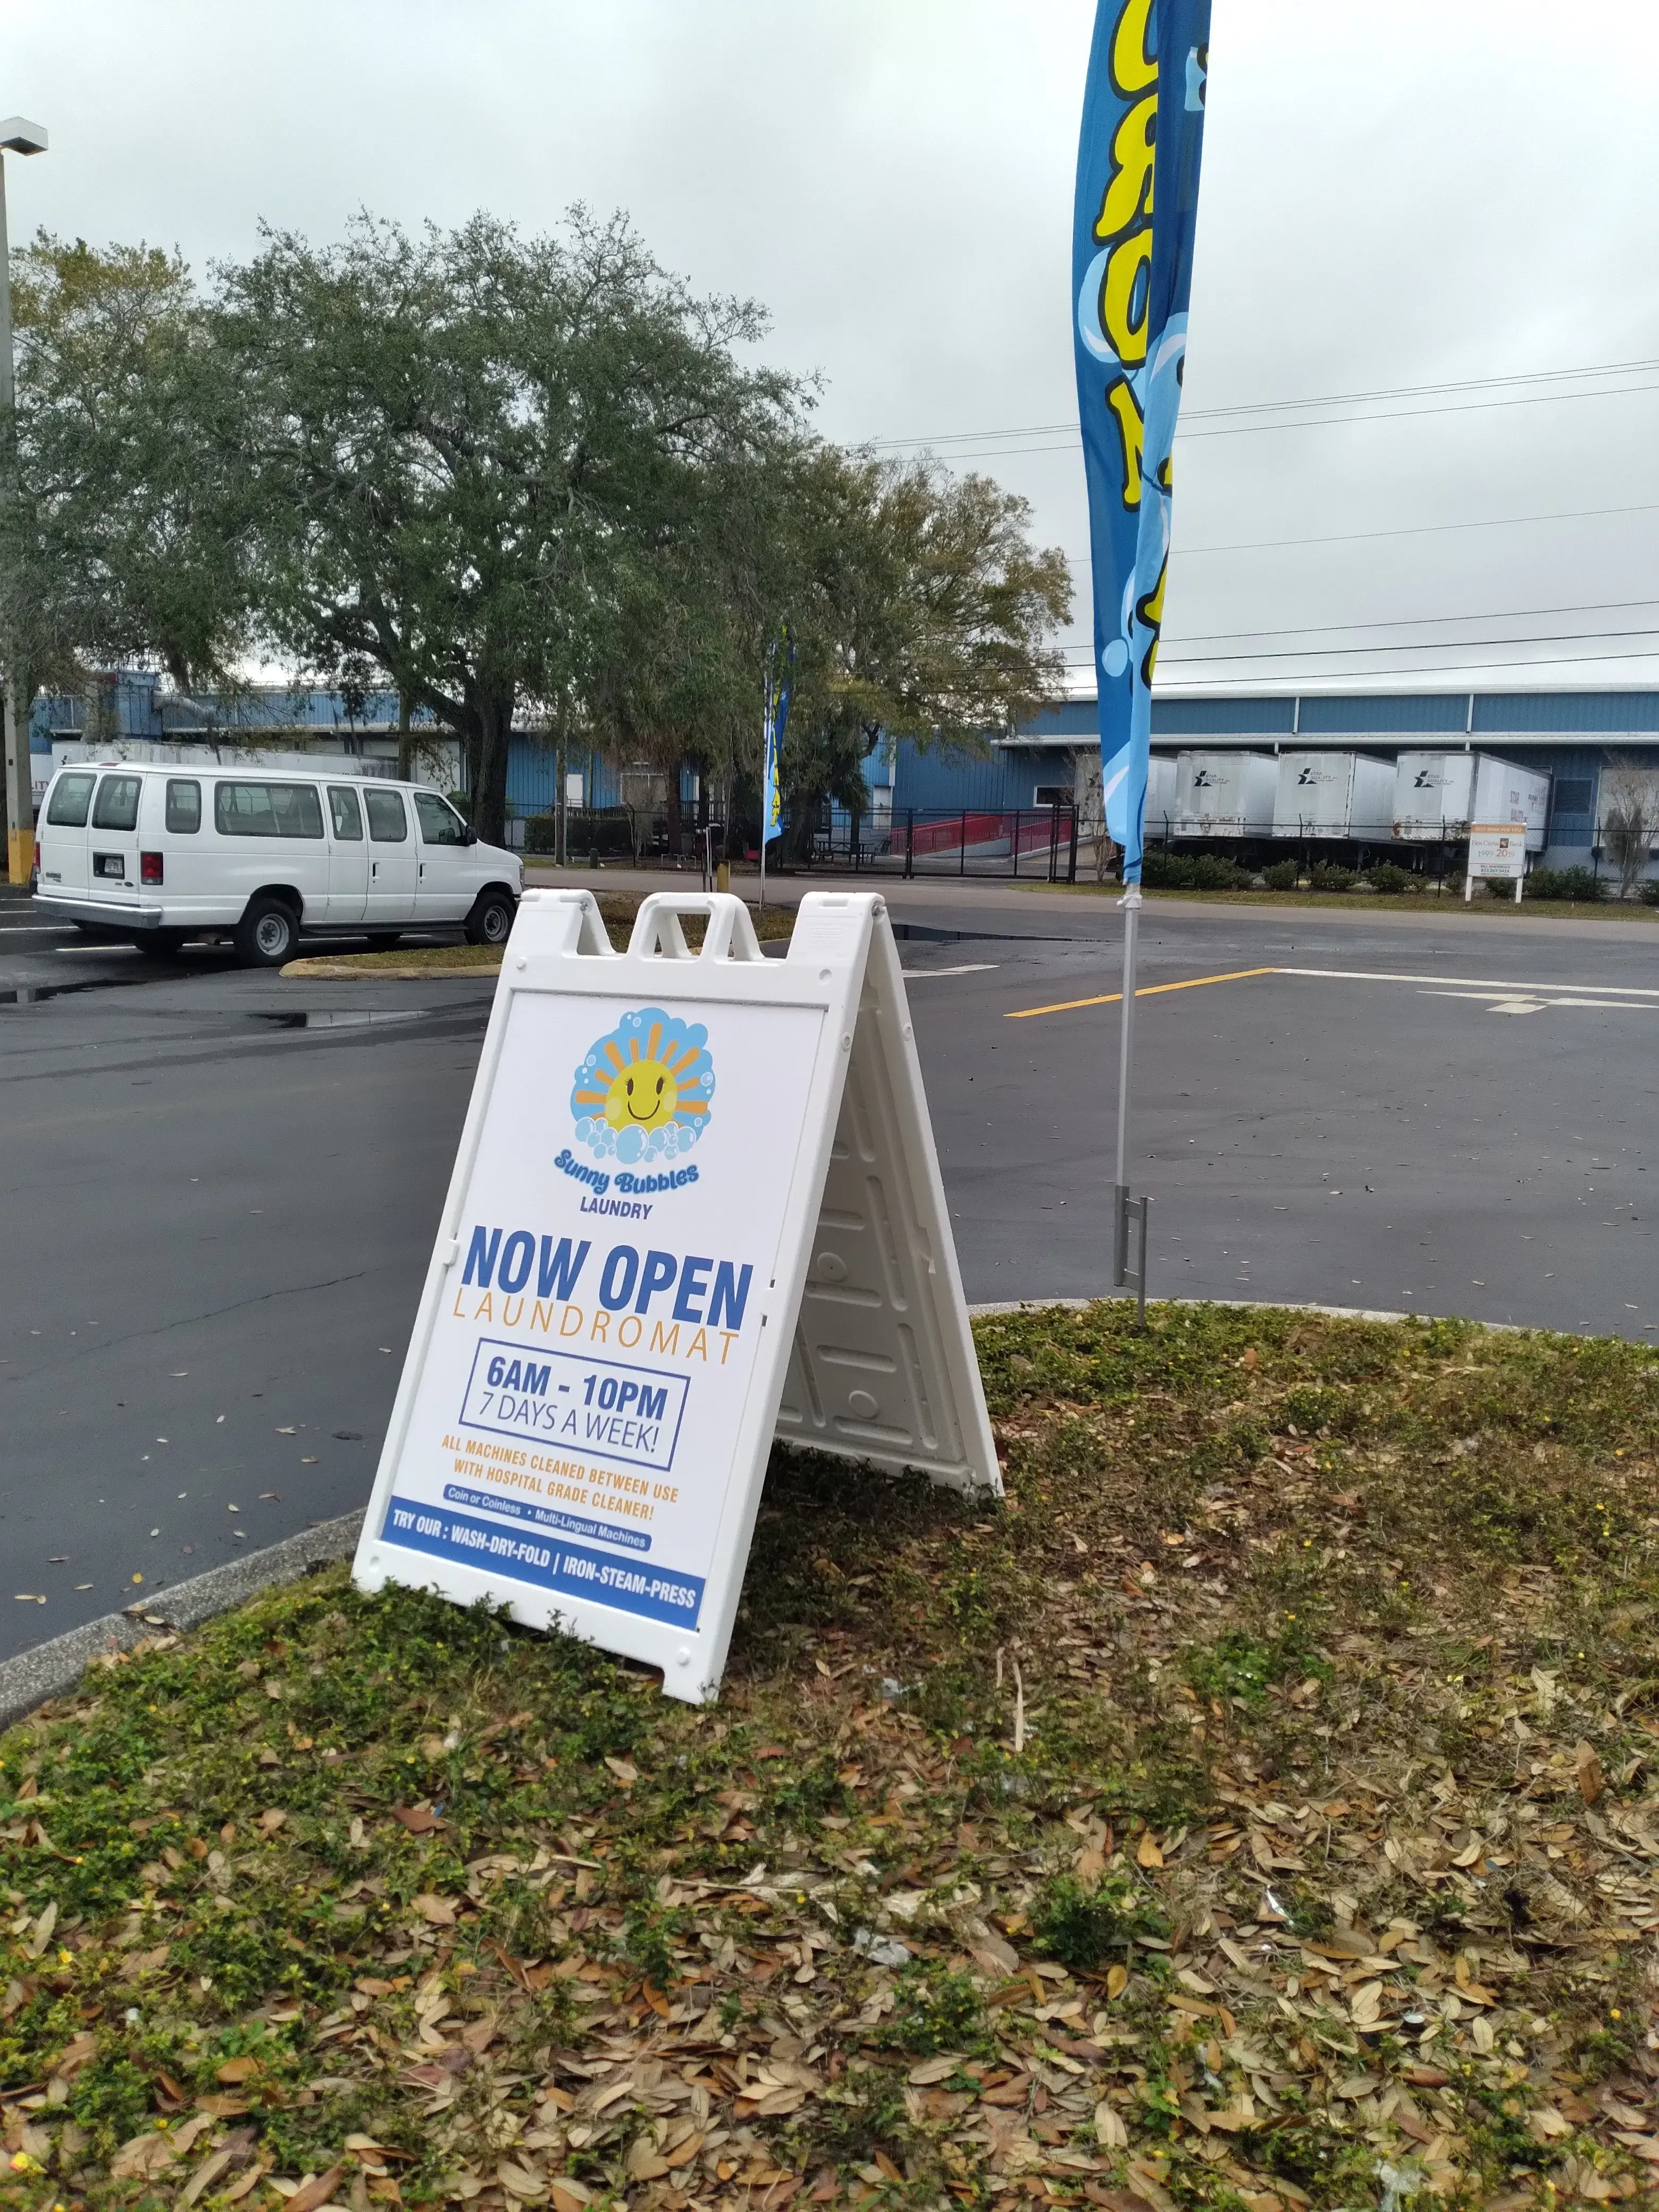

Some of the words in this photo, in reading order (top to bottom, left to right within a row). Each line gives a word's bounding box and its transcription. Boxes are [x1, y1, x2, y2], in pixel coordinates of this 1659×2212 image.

[554, 1149, 610, 1194] Sunny
[614, 1164, 699, 1194] Bubbles
[580, 1196, 653, 1220] LAUNDRY
[462, 1225, 592, 1302] NOW
[599, 1245, 754, 1331] OPEN
[453, 1287, 739, 1365] LAUNDROMAT
[487, 1356, 551, 1396] 6AM
[583, 1374, 669, 1421] 10PM
[479, 1391, 494, 1415] 7
[498, 1395, 559, 1430] DAYS
[560, 1409, 577, 1436] A
[586, 1413, 660, 1453] WEEK!
[441, 1435, 461, 1451] ALL
[465, 1439, 527, 1467] MACHINES
[530, 1454, 585, 1480] CLEANED
[589, 1468, 649, 1496] BETWEEN
[653, 1482, 679, 1503] USE
[454, 1458, 484, 1478] WITH
[486, 1466, 542, 1494] HOSPITAL
[547, 1480, 589, 1504] GRADE
[592, 1492, 655, 1520] CLEANER!
[448, 1487, 469, 1501] Coin
[470, 1494, 481, 1504] or
[482, 1496, 521, 1515] Coinless
[535, 1509, 597, 1535] Multi-Lingual
[598, 1524, 646, 1548] Machines
[393, 1508, 415, 1529] TRY
[416, 1515, 441, 1537] OUR
[450, 1524, 551, 1569] WASH-DRY-FOLD
[563, 1555, 697, 1610] IRON-STEAM-PRESS
